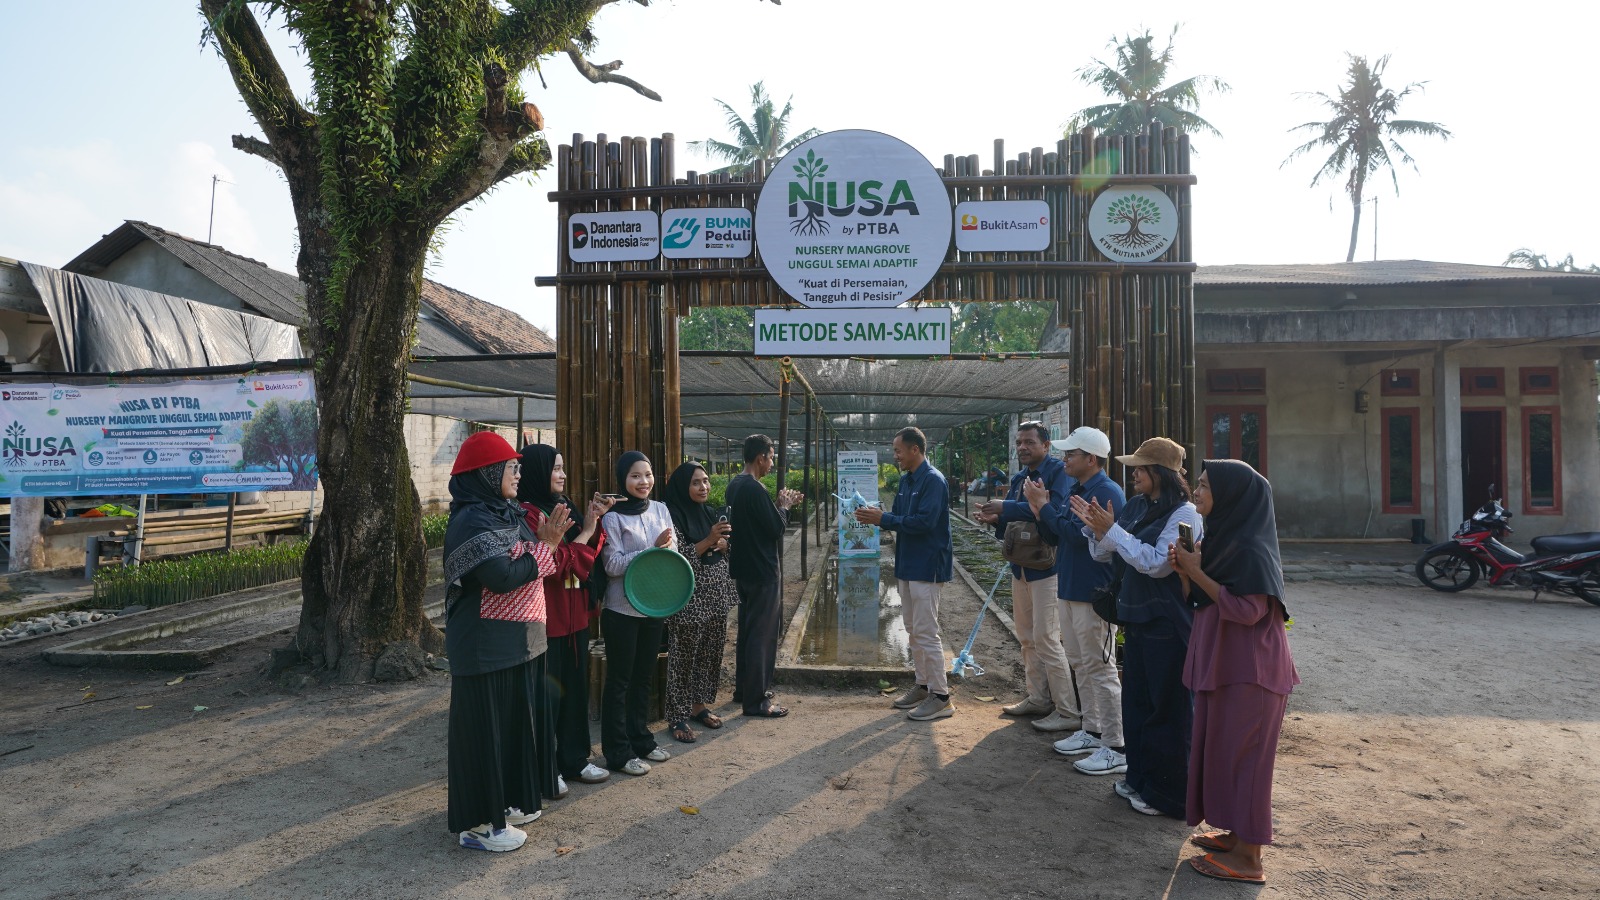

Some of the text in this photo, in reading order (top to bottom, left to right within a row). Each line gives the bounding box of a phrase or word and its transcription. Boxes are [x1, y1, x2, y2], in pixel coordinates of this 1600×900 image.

[788, 180, 920, 218] NUSA
[590, 221, 642, 234] Danantara
[706, 218, 750, 228] BUMN
[842, 222, 899, 235] by PTBA
[590, 235, 638, 248] Indonesia
[706, 230, 750, 241] Peduli
[795, 245, 910, 255] NURSERY MANGROVE
[1099, 237, 1111, 250] KTH
[1112, 248, 1145, 258] MUTIARA
[1146, 242, 1164, 255] HIJAU
[788, 258, 918, 269] UNGGUL SEMAI ADAPTIF
[831, 279, 840, 288] di
[844, 278, 907, 288] Persemaian,
[804, 292, 847, 303] Tangguh
[851, 292, 860, 301] di
[759, 322, 946, 341] METODE SAM-SAKTI
[119, 397, 200, 412] NUSA BY PTBA
[65, 411, 252, 426] NURSERY MANGROVE UNGGUL SEMAI ADAPTIF
[3, 437, 76, 457] NUSA
